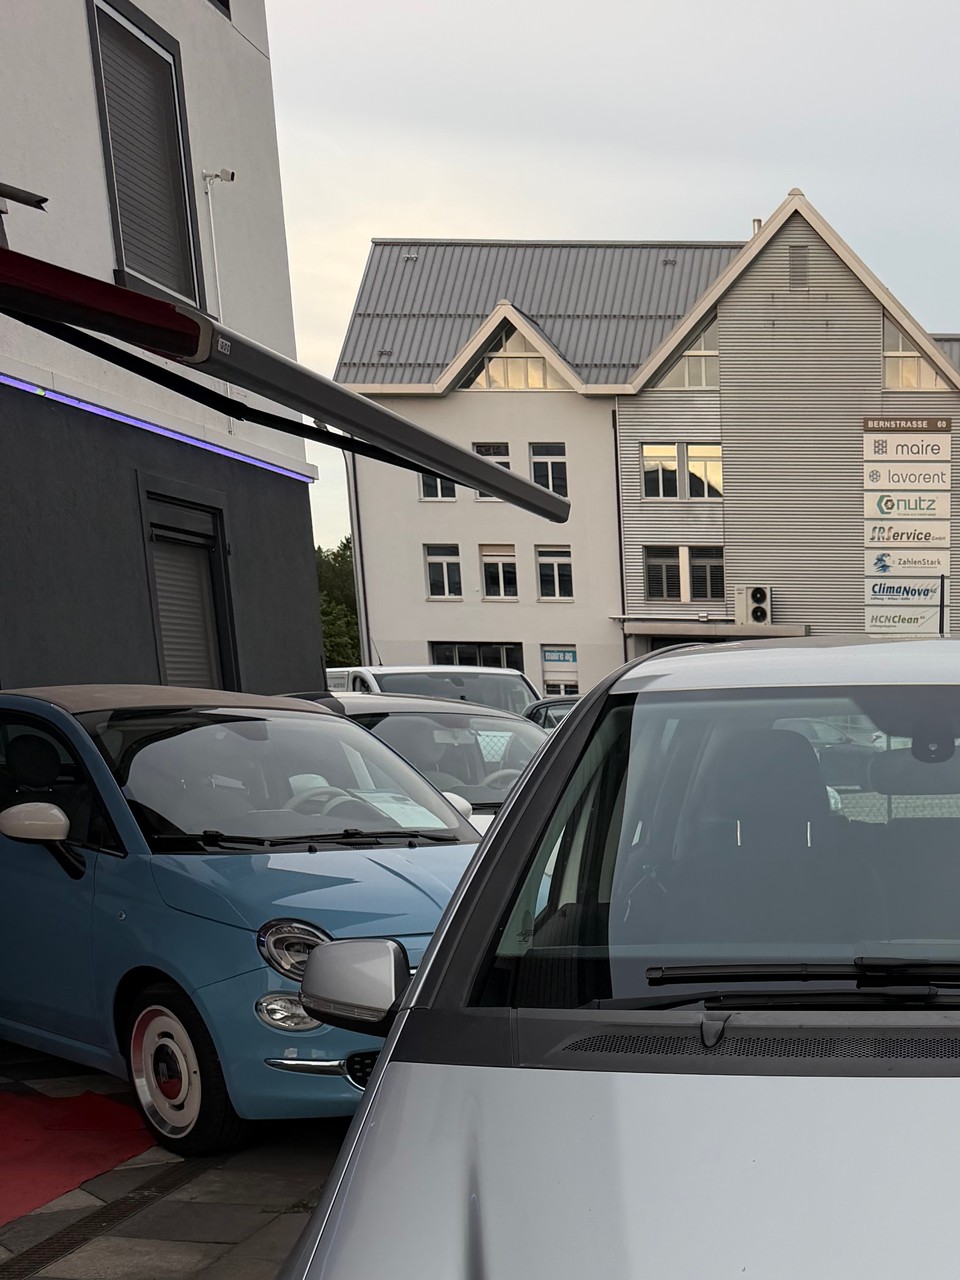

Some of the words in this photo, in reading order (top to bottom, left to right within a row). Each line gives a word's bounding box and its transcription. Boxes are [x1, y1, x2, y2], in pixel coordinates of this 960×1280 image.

[895, 440, 941, 455] maire
[888, 469, 946, 483] lavorent
[896, 496, 936, 511] nutz
[898, 558, 941, 566] ZahlenStark
[872, 583, 929, 596] ClimaNova
[870, 615, 919, 624] HCNClean
